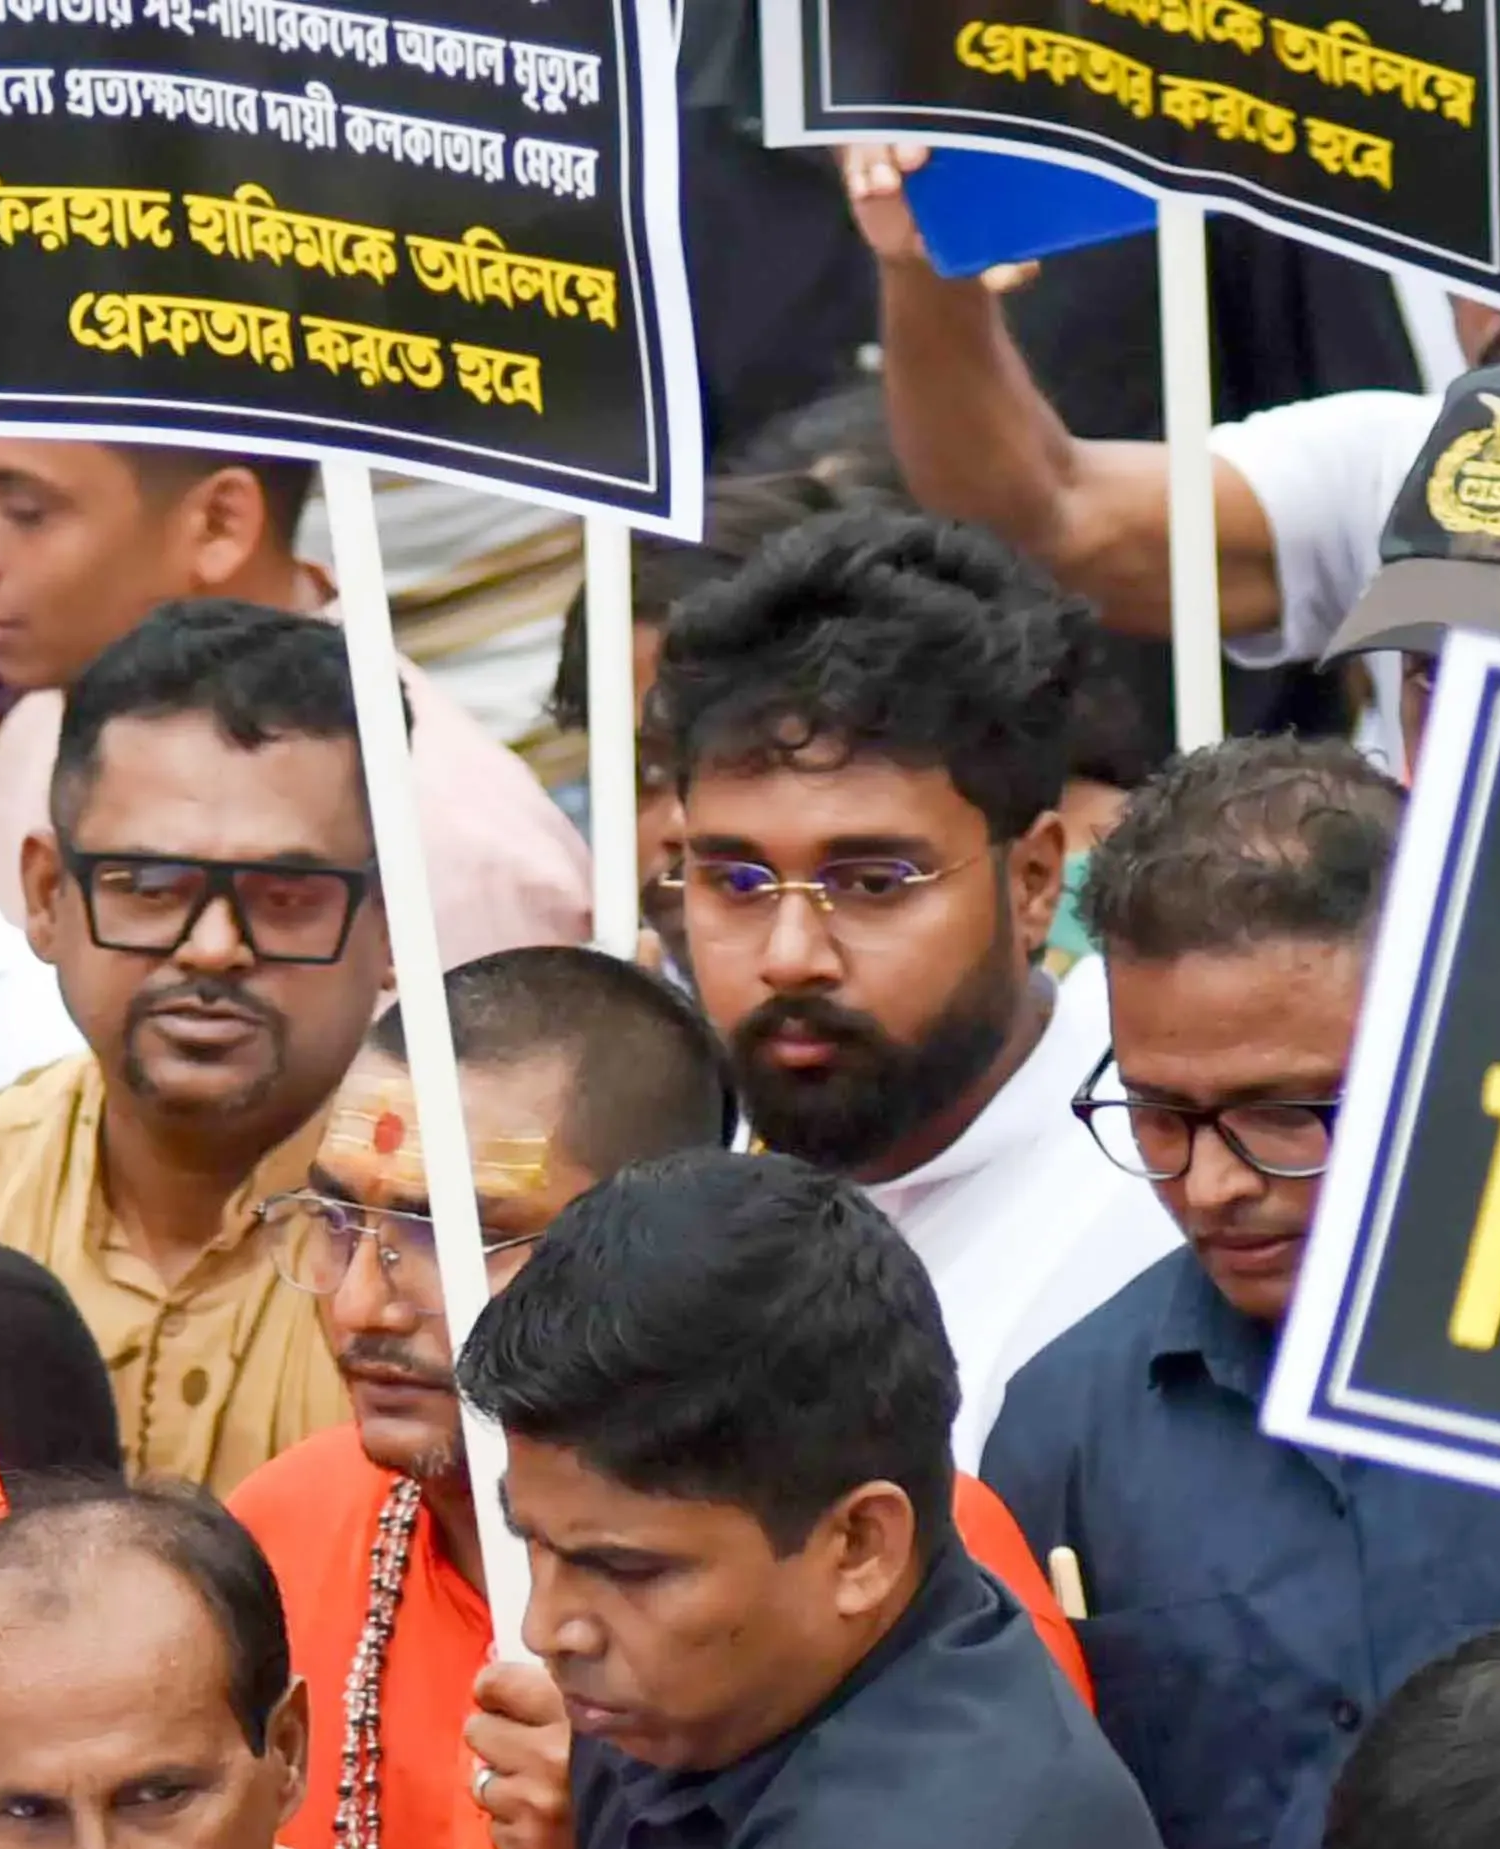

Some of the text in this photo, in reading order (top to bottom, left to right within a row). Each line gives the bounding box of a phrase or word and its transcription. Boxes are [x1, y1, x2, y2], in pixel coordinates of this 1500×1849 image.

[392, 20, 506, 86] অকাল
[956, 20, 1394, 191] গ্রেফতার করতে হবে
[1267, 18, 1475, 128] অবিলম্বে
[63, 68, 260, 134] প্রত্যক্ষভাবে
[261, 80, 338, 150] দায়ী
[341, 104, 506, 183] কলকাতার
[513, 137, 599, 200] মেয়র
[182, 181, 397, 286] হাকিমকে
[404, 228, 618, 330] অবিলম্বে
[68, 290, 545, 415] গ্রেফতার করতে হবে
